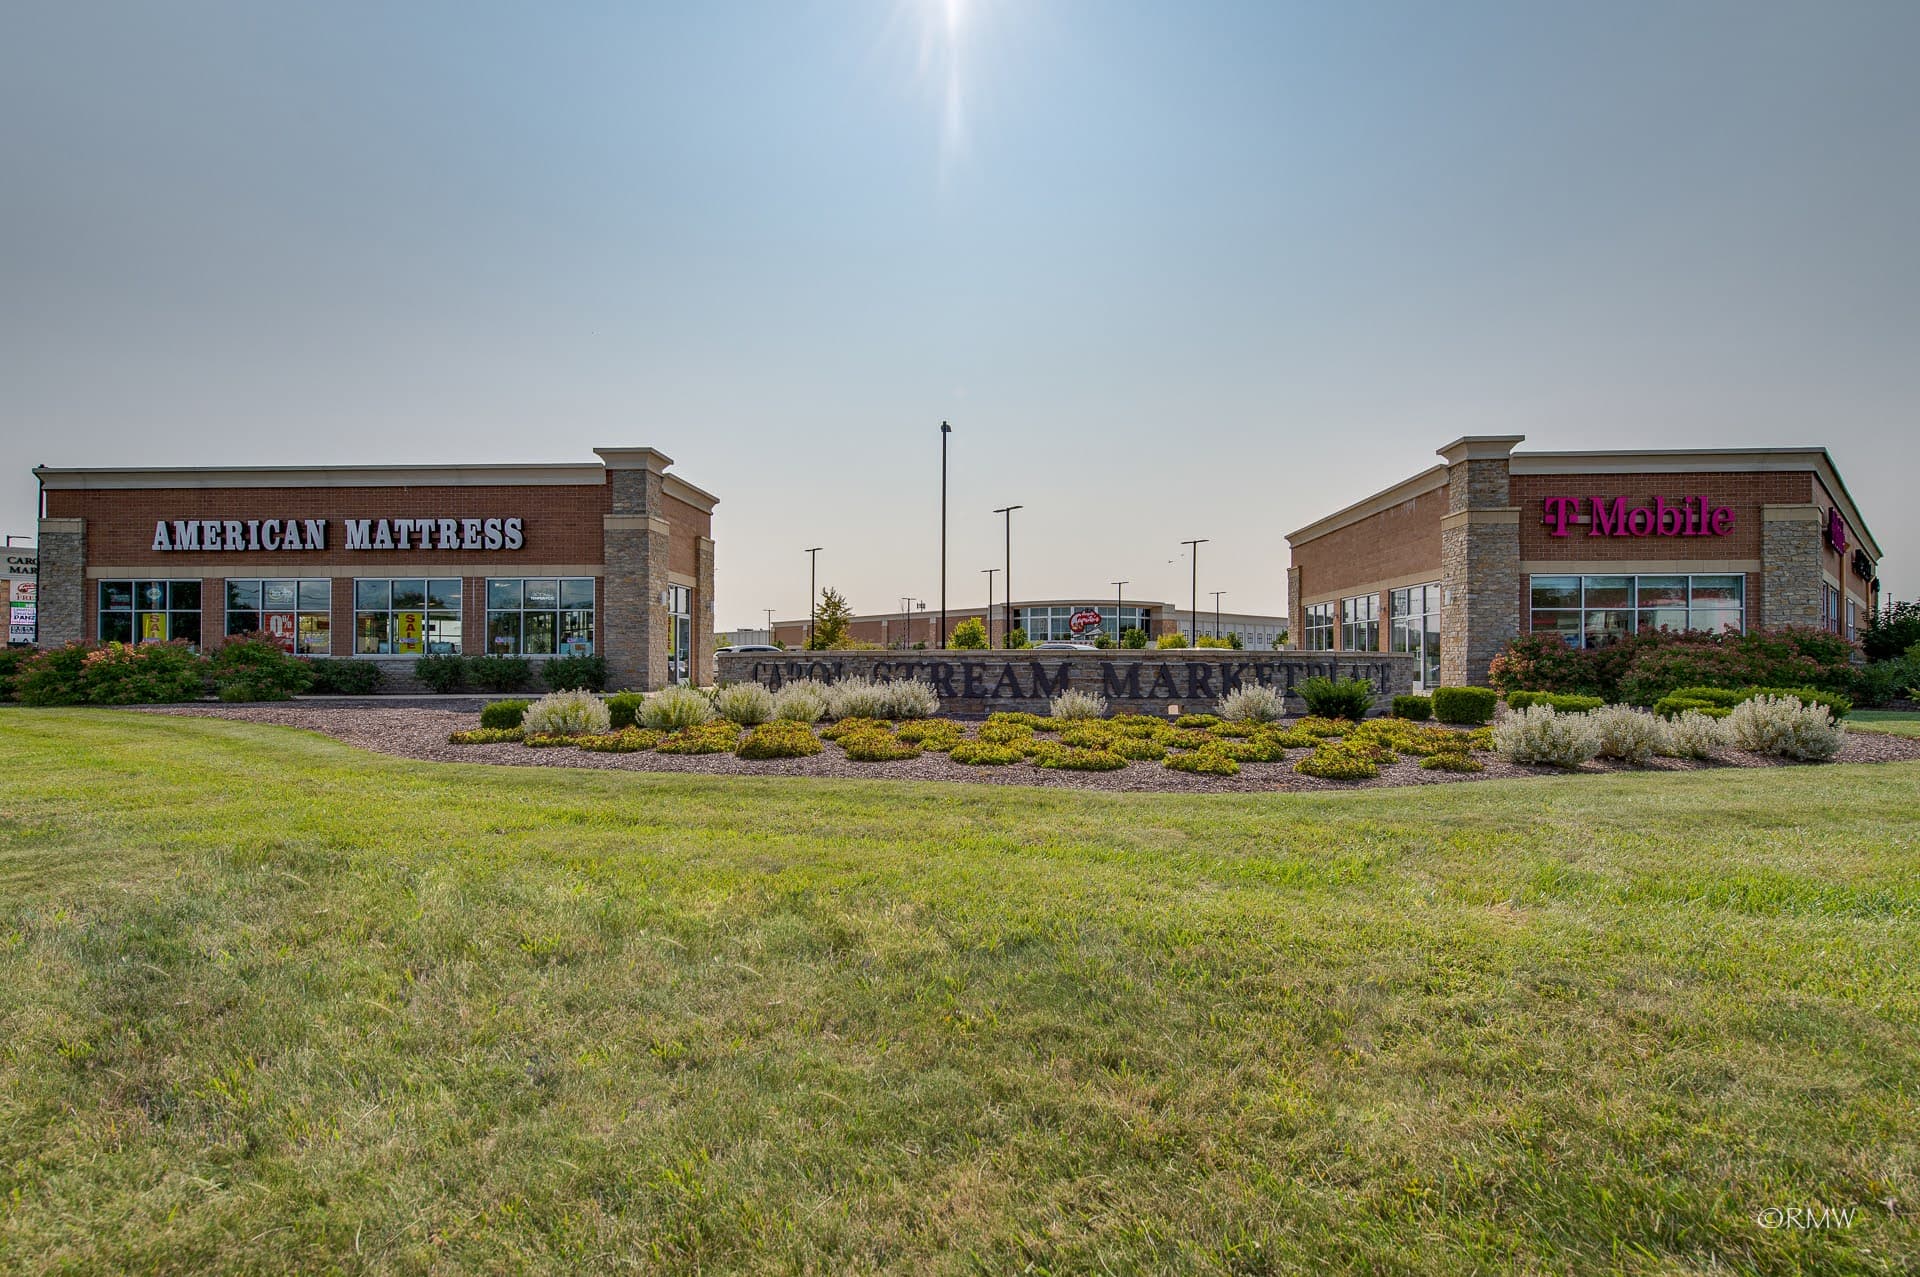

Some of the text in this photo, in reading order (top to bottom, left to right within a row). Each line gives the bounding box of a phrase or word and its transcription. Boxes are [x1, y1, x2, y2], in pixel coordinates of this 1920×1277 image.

[151, 518, 524, 551] AMERICAN MATTRESS
[405, 613, 416, 649] SALE
[873, 661, 1073, 699] STREAM
